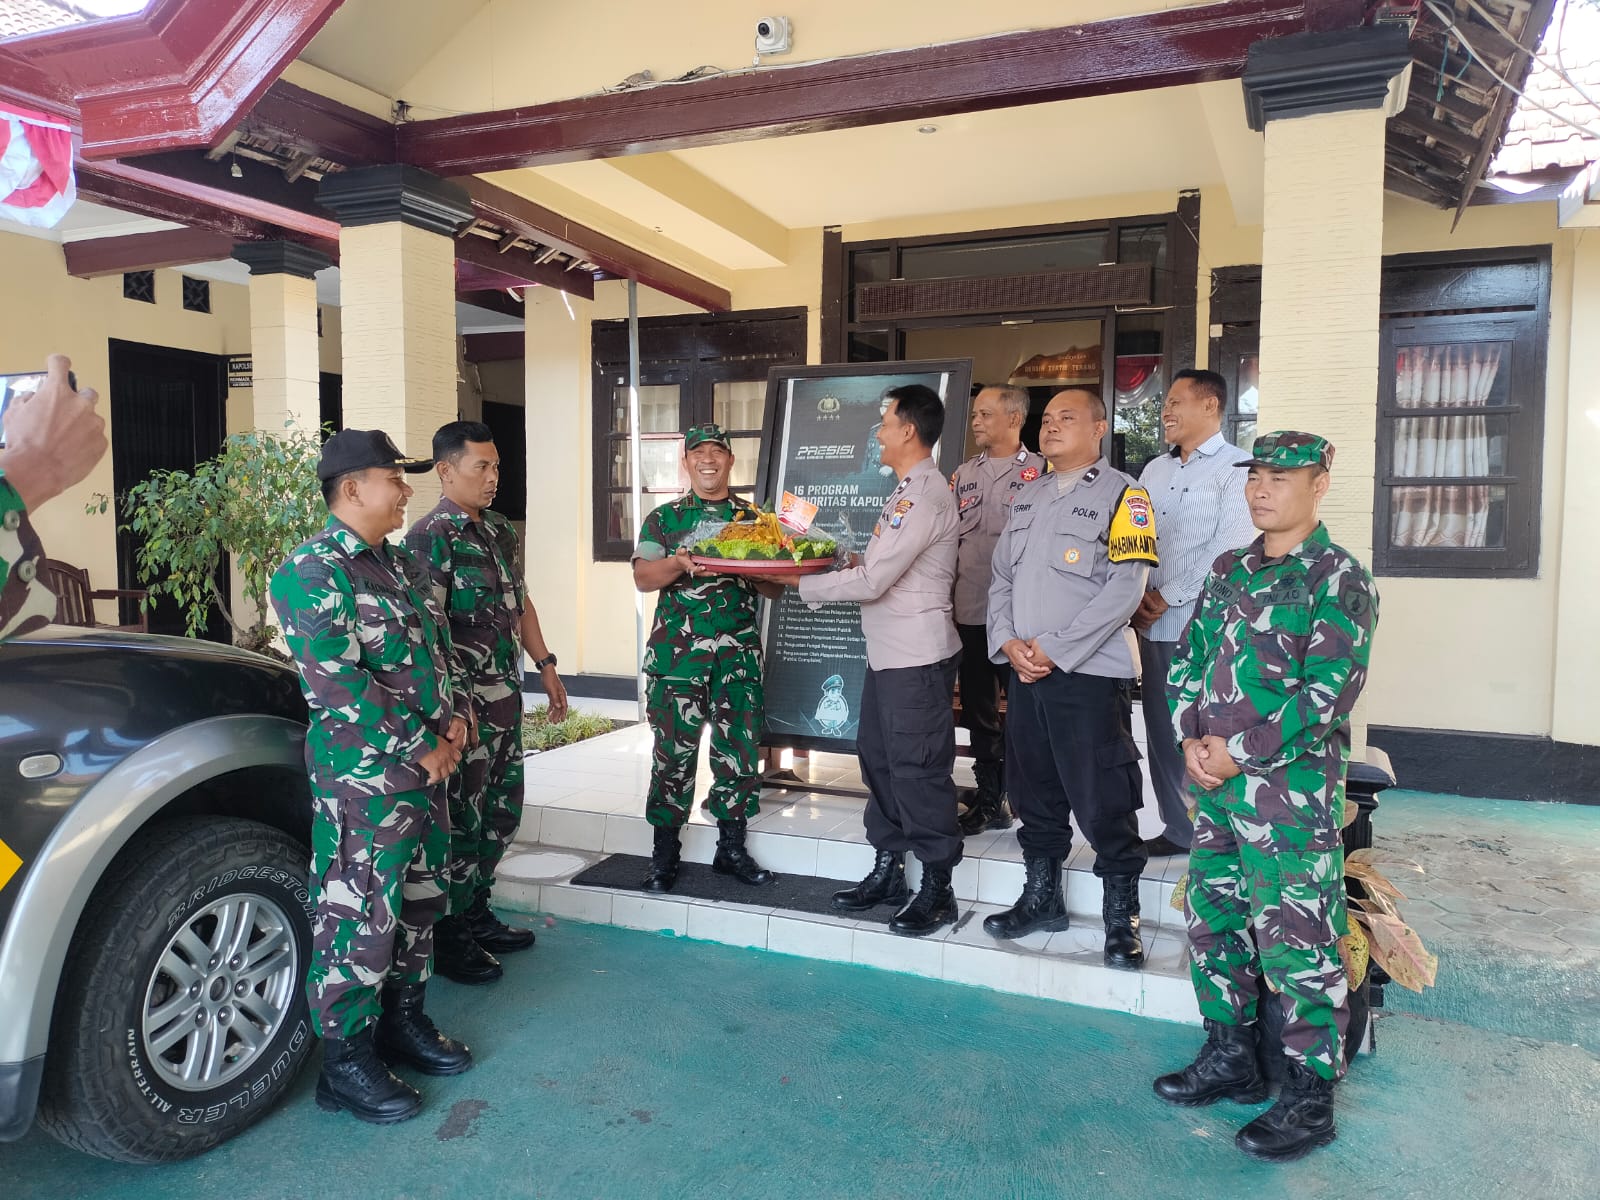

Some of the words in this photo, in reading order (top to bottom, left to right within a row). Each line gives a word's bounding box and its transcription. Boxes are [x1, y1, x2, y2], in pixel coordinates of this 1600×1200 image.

[796, 444, 855, 456] PRESISI
[794, 485, 805, 496] 16
[807, 484, 859, 496] PROGRAM
[850, 496, 889, 507] KAPOL
[1014, 503, 1034, 513] FERRY
[1071, 506, 1099, 521] POLRI
[177, 1020, 308, 1124] DUELER
